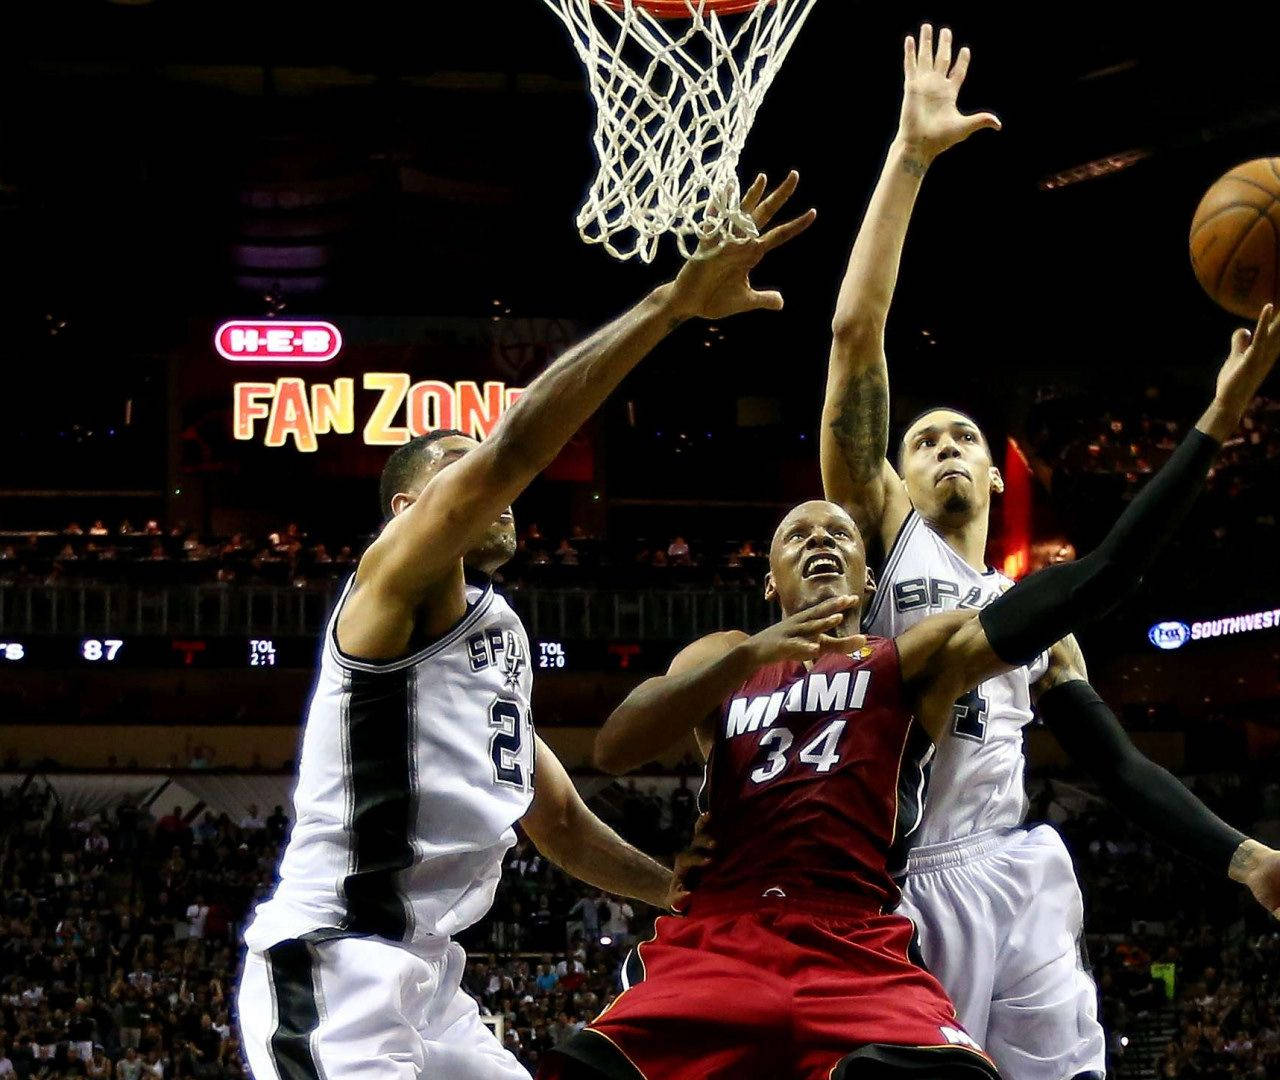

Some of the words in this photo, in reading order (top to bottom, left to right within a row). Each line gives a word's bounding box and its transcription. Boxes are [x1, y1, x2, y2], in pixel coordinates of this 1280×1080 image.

[230, 329, 331, 353] H-E-B
[233, 376, 355, 452] FAN
[363, 372, 527, 446] ZON
[83, 640, 123, 660] 87
[250, 640, 276, 653] TOL
[539, 642, 565, 655] TOL
[250, 653, 276, 666] 2:1
[539, 655, 565, 668] 2:0
[725, 670, 871, 739] MIAMI
[751, 720, 848, 784] 34
